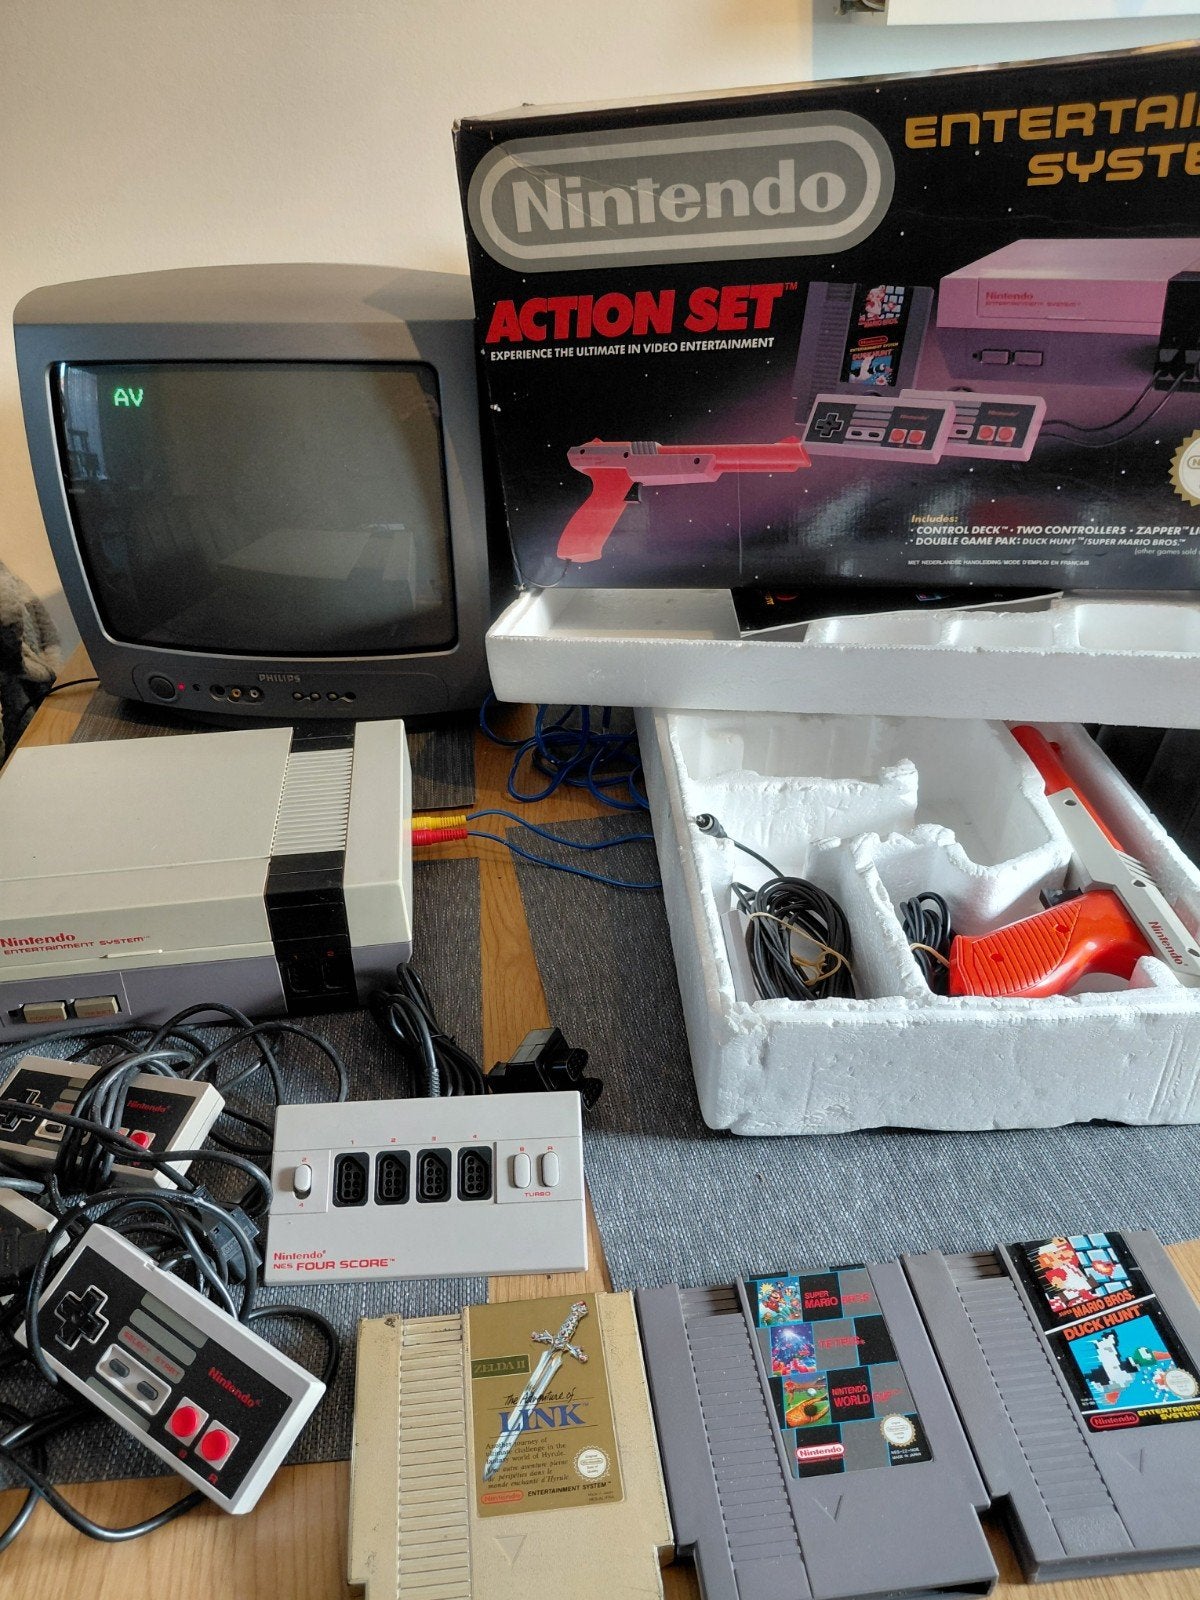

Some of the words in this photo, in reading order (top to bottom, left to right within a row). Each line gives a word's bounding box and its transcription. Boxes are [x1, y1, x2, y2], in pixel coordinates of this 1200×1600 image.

[905, 91, 1200, 149] ENTERTAI
[511, 159, 846, 232] Nintendo
[485, 289, 676, 344] ACTION
[490, 349, 552, 361] EXPERIENCE
[555, 347, 574, 357] THE
[576, 344, 625, 356] ULTIMATE
[628, 344, 641, 354] IN
[643, 342, 677, 353] VIDEO
[680, 337, 775, 352] ENTERTAINMENT
[114, 389, 143, 407] AV
[911, 514, 958, 523] Includes:
[916, 526, 969, 534] CONTROL
[1016, 526, 1043, 534] TWO
[1045, 526, 1126, 535] CONTROLLERS
[915, 537, 959, 545] DOUBLE
[960, 537, 993, 545] GAME
[994, 537, 1020, 545] PAK:
[1135, 547, 1155, 556] (other
[1157, 549, 1180, 557] games
[1182, 547, 1198, 555] sold
[258, 674, 301, 682] PHILIPS
[0, 933, 76, 947] Nintendo
[1148, 921, 1185, 965] Nintendo
[4, 942, 94, 955] ENTERTAINMENT
[127, 1100, 168, 1113] Nintendo
[273, 1250, 324, 1260] Nintendo
[296, 1261, 336, 1271] FOUR
[804, 1290, 829, 1299] SUPER
[804, 1296, 839, 1309] MARIO
[1072, 1298, 1105, 1318] MARIO
[1063, 1318, 1104, 1341] DUCK
[1103, 1305, 1141, 1327] HUNT
[474, 1361, 514, 1373] ZELDA
[517, 1360, 526, 1369] II
[208, 1367, 255, 1408] Nintendo
[832, 1385, 868, 1396] NINTENDO
[504, 1394, 519, 1406] The
[566, 1387, 576, 1403] of
[834, 1393, 871, 1408] WORLD
[1093, 1415, 1136, 1426] Nintendo
[800, 1446, 842, 1457] Nintendo
[485, 1493, 520, 1502] Nintendo
[528, 1485, 580, 1497] ENTERTAINMENT
